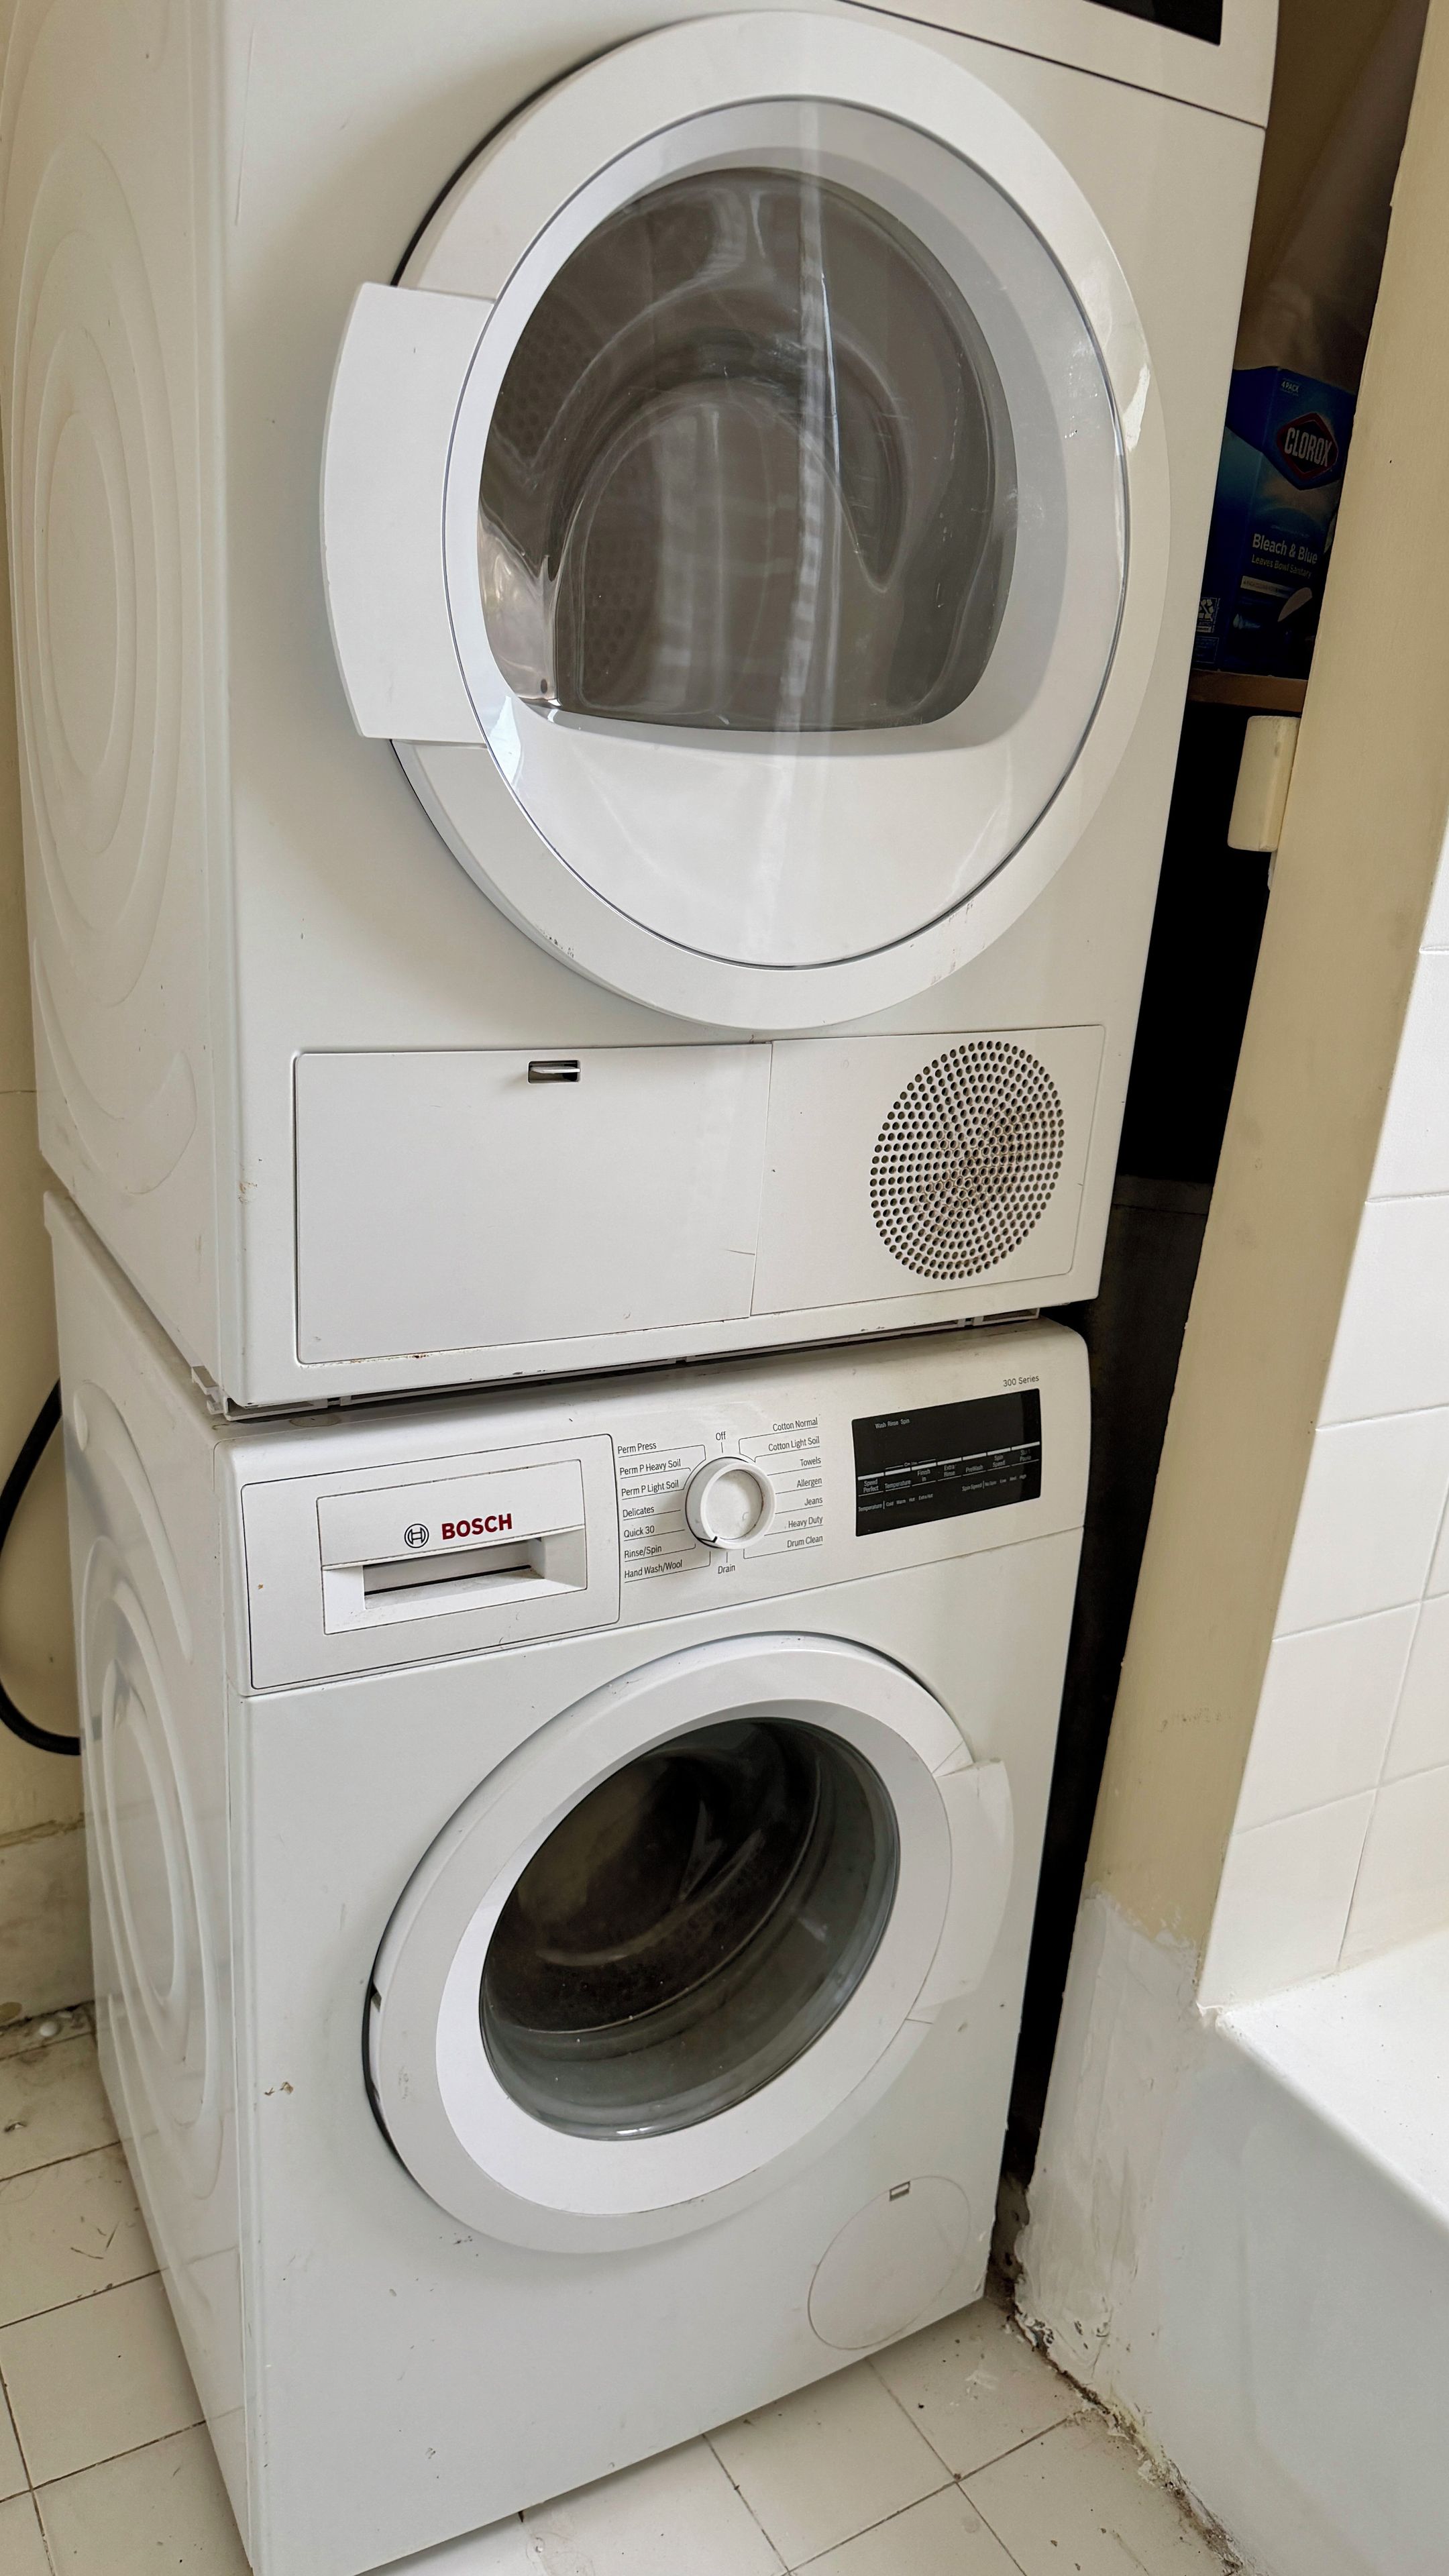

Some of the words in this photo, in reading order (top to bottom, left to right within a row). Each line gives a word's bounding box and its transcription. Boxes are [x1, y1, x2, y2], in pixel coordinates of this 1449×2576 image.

[1284, 427, 1333, 468] CLOROX
[1252, 533, 1287, 556] Bleach
[1289, 543, 1296, 558] &
[1298, 546, 1318, 564] Blue
[1251, 554, 1273, 568] Leaves
[1003, 1379, 1016, 1387] 300
[1018, 1375, 1039, 1385] Series
[773, 1423, 794, 1432] Cotton
[795, 1417, 818, 1428] Normal
[715, 1432, 727, 1440] Off
[618, 1446, 637, 1454] Perm
[638, 1442, 657, 1451] Press
[768, 1442, 790, 1452] Cotton
[791, 1439, 806, 1450] Light
[807, 1436, 819, 1446] Soil
[620, 1466, 639, 1476] Perm
[639, 1464, 645, 1472] P
[645, 1461, 667, 1472] Heavy
[668, 1458, 681, 1468] Soil
[800, 1457, 821, 1466] Towels
[621, 1487, 640, 1497] Perm
[641, 1485, 646, 1493] P
[647, 1483, 664, 1494] Light
[665, 1480, 679, 1489] Soil
[797, 1477, 822, 1488] Allergen
[863, 1485, 879, 1493] Perfect
[864, 1479, 878, 1487] Speed
[884, 1479, 912, 1489] Temperature
[804, 1497, 823, 1507] Jeans
[858, 1503, 882, 1512] Temperature
[623, 1505, 655, 1518] Delicates
[441, 1513, 512, 1540] BOSCH
[788, 1519, 807, 1529] Heavy
[808, 1515, 823, 1526] Duty
[624, 1527, 643, 1538] Quick
[645, 1525, 655, 1535] 30
[787, 1539, 804, 1548] Drum
[806, 1535, 823, 1545] Clean
[624, 1545, 662, 1559] Rinse/Spin
[625, 1568, 643, 1578] Hand
[644, 1560, 682, 1576] Wash/Wool
[718, 1564, 735, 1574] Drain
